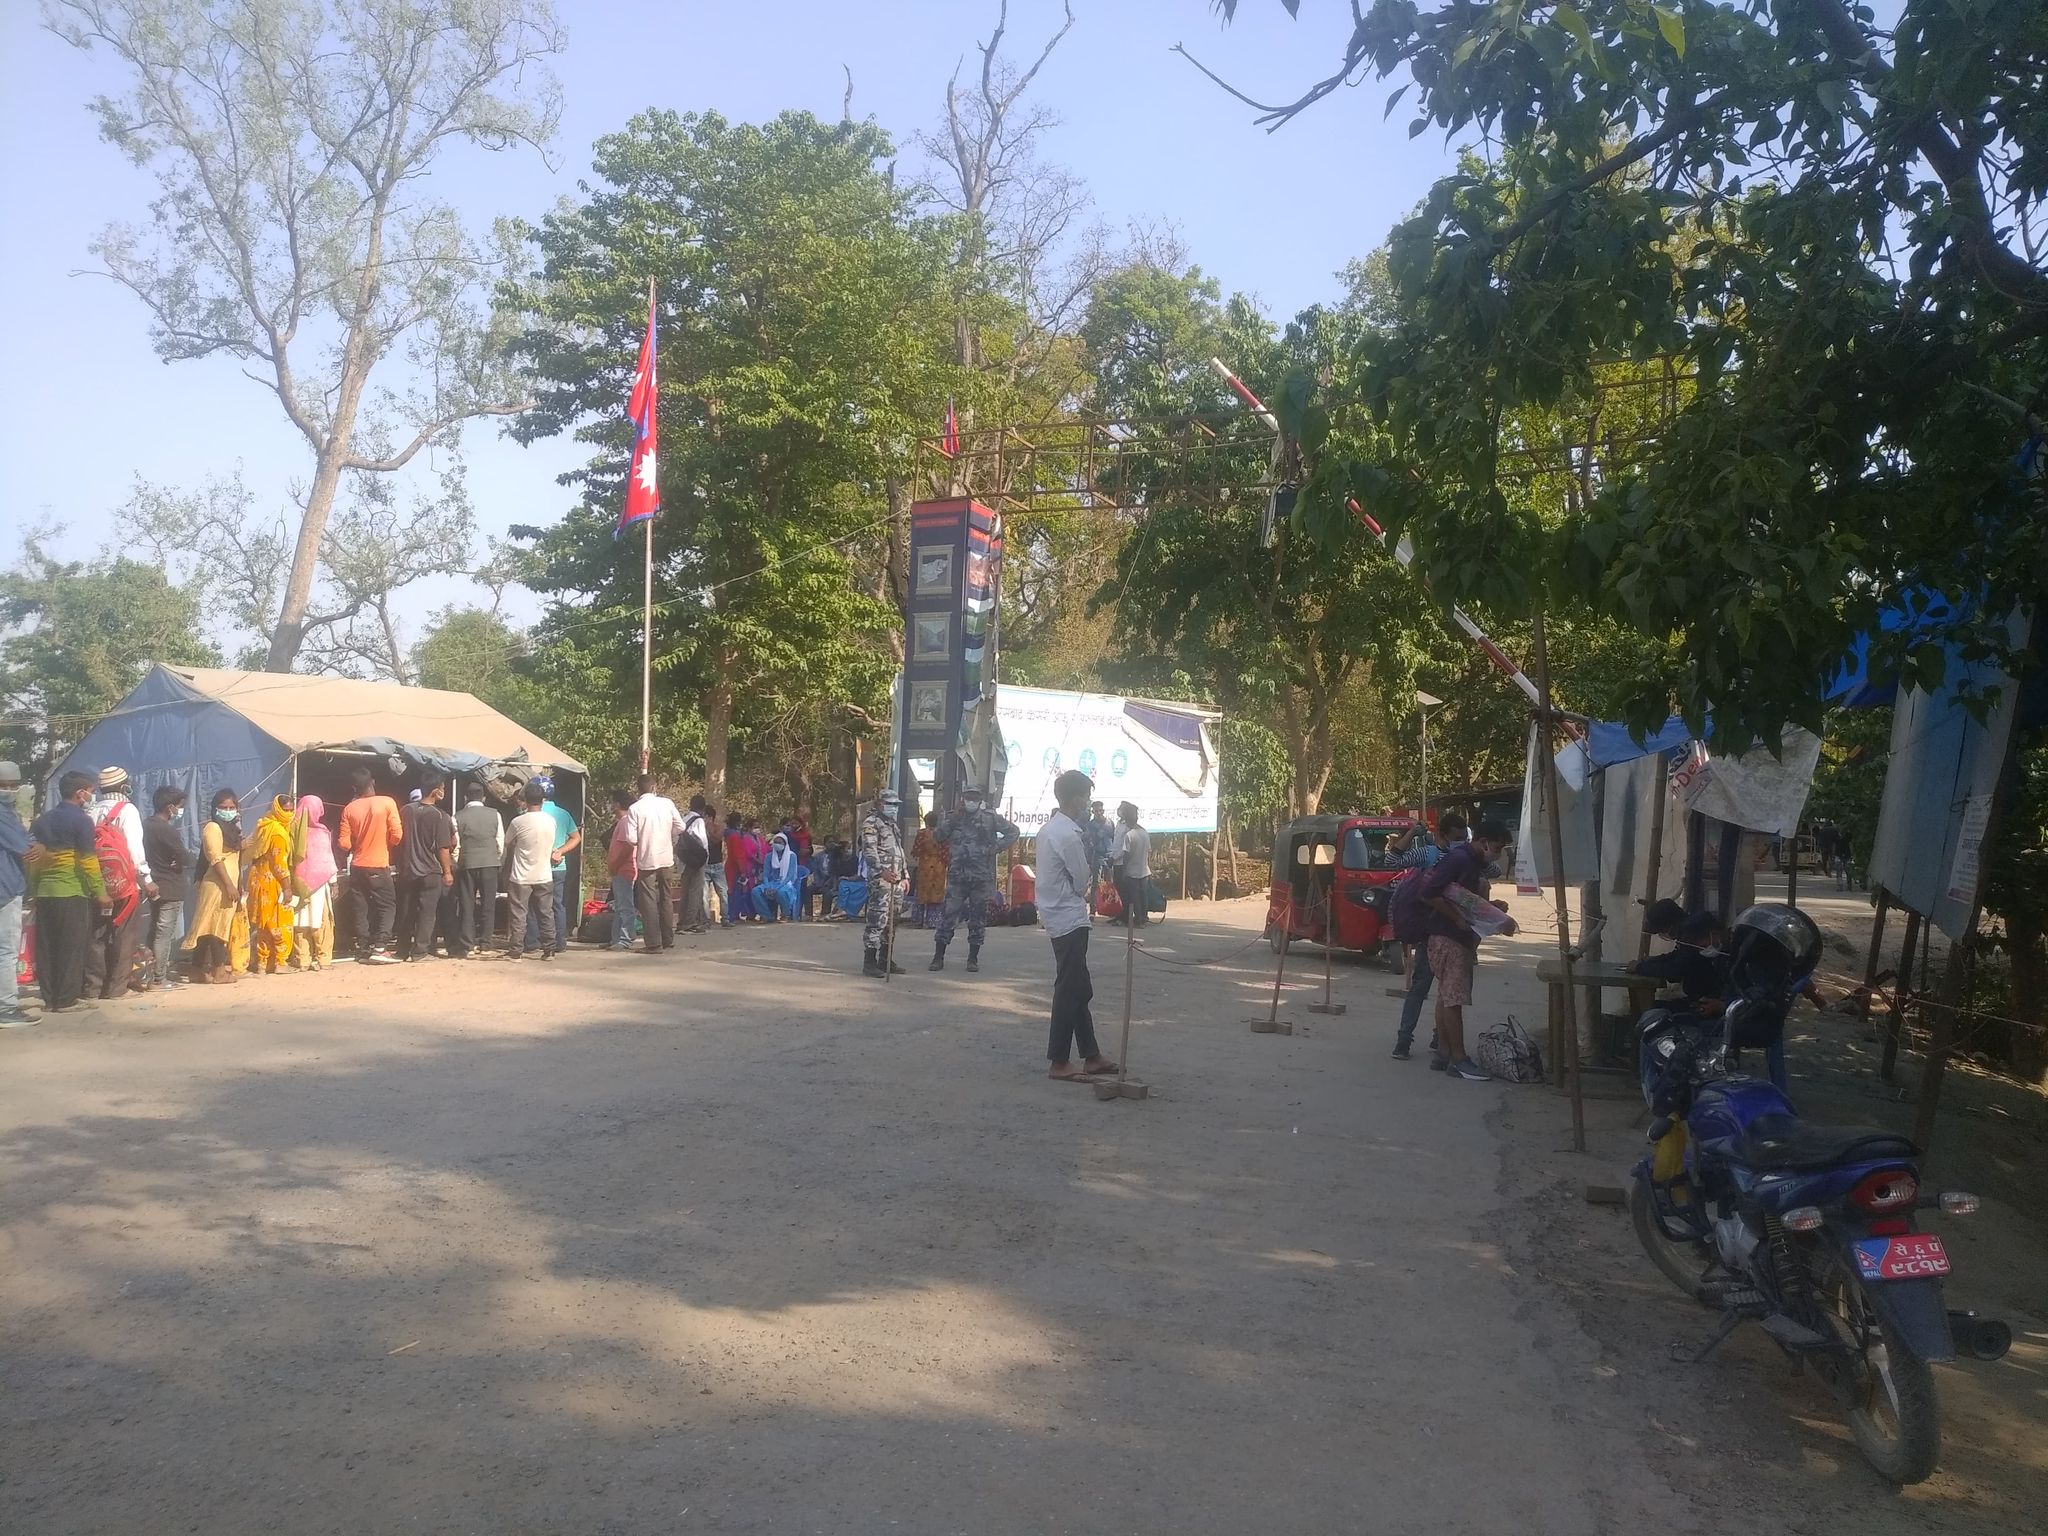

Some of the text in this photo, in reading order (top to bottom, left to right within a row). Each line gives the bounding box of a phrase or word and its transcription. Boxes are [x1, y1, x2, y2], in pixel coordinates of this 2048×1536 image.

[1011, 810, 1050, 825] Dhanga
[1893, 1242, 1941, 1256] से ६ प
[1863, 1270, 1881, 1278] NEPAL
